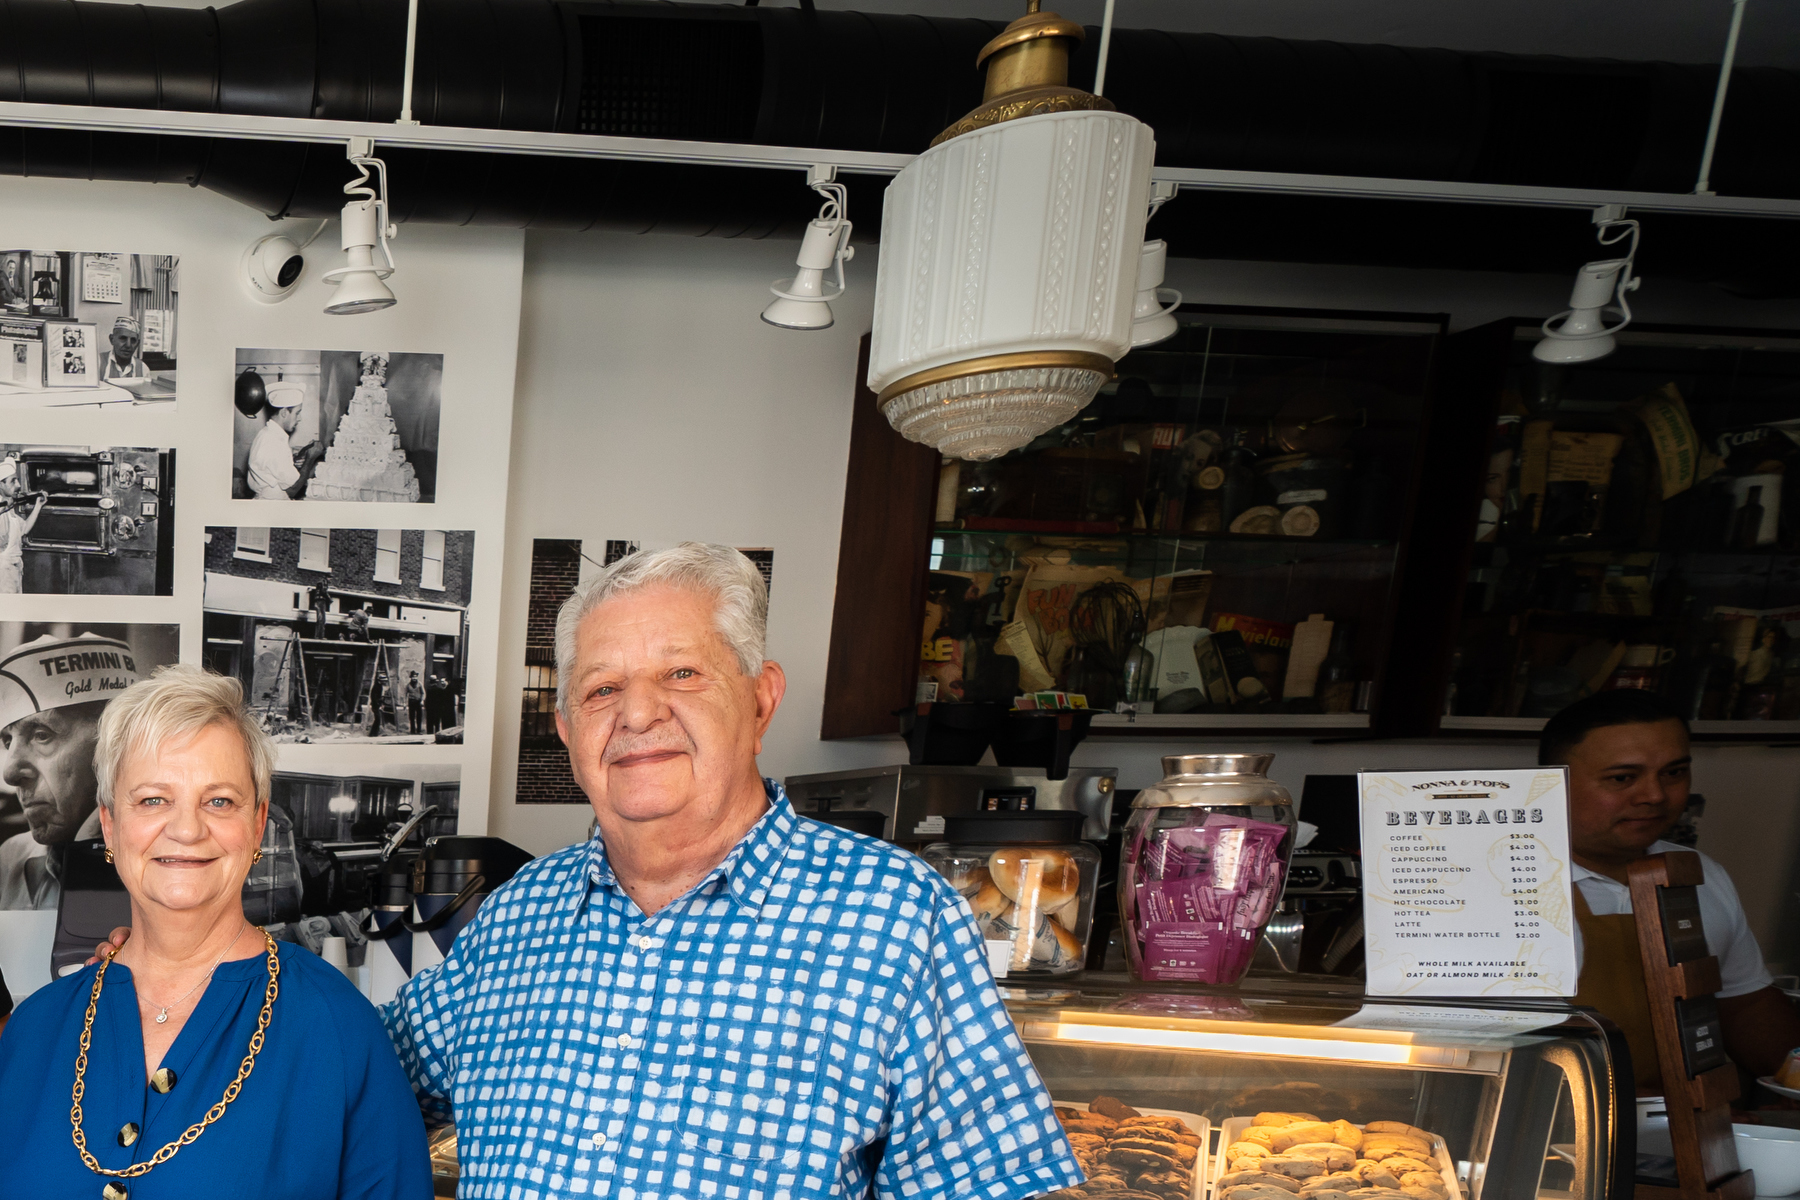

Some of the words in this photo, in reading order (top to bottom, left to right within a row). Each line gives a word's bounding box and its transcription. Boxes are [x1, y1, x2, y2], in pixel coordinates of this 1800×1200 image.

[1027, 584, 1076, 615] FUN
[38, 651, 122, 677] TERMINI
[64, 678, 92, 699] Gold
[98, 677, 128, 692] Medal
[1411, 780, 1457, 792] NONNA
[1460, 779, 1471, 787] &
[1385, 808, 1545, 826] BEVERAGES
[1406, 971, 1424, 979] OAT
[1426, 971, 1439, 979] OR
[1441, 971, 1479, 979] ALMOND
[1482, 971, 1505, 979] MILK
[1513, 971, 1539, 979] $1.00
